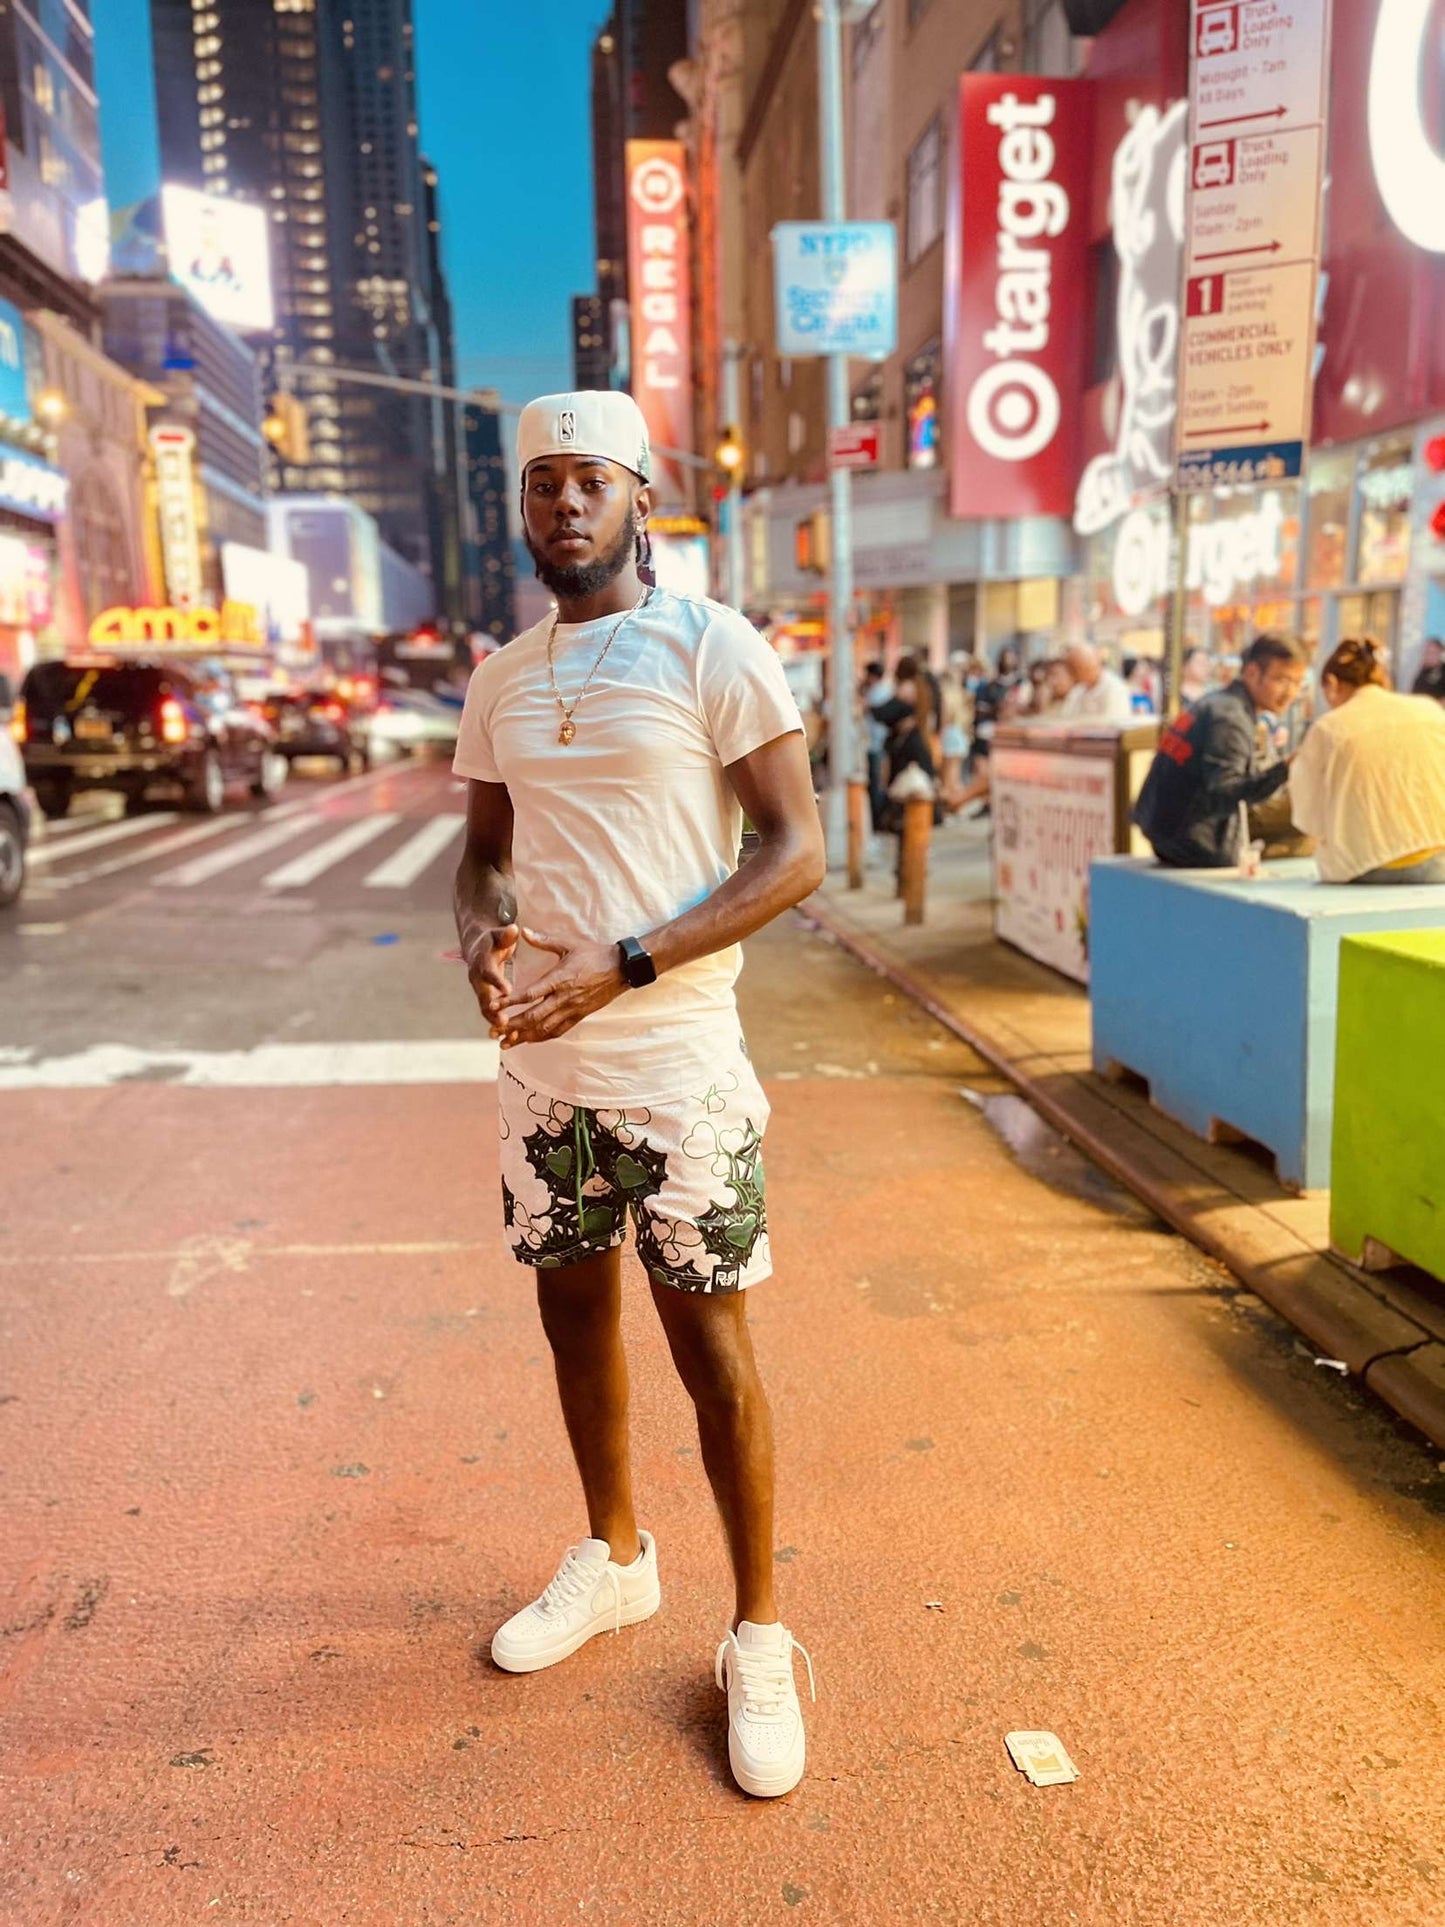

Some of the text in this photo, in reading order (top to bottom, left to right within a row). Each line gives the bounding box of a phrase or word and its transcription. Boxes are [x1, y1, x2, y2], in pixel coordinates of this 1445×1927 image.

[1244, 3, 1277, 18] Truck
[1243, 15, 1293, 34] Loading
[1243, 36, 1271, 50] Only
[1200, 66, 1248, 84] Midnight
[1216, 88, 1245, 102] Days
[1241, 139, 1273, 153] Truck
[1240, 152, 1288, 169] Loading
[1239, 171, 1266, 184] Only
[1195, 204, 1237, 219] Sunday
[983, 93, 1069, 357] target
[1235, 218, 1262, 232] 2pm
[1198, 278, 1212, 314] 1
[641, 224, 679, 389] REGAL
[1189, 322, 1277, 348] COMMERCIAL
[1188, 339, 1295, 367] VEHICLES ONLY
[1227, 384, 1254, 399] 2pm
[1226, 400, 1269, 416] Sunday
[88, 606, 220, 646] amc
